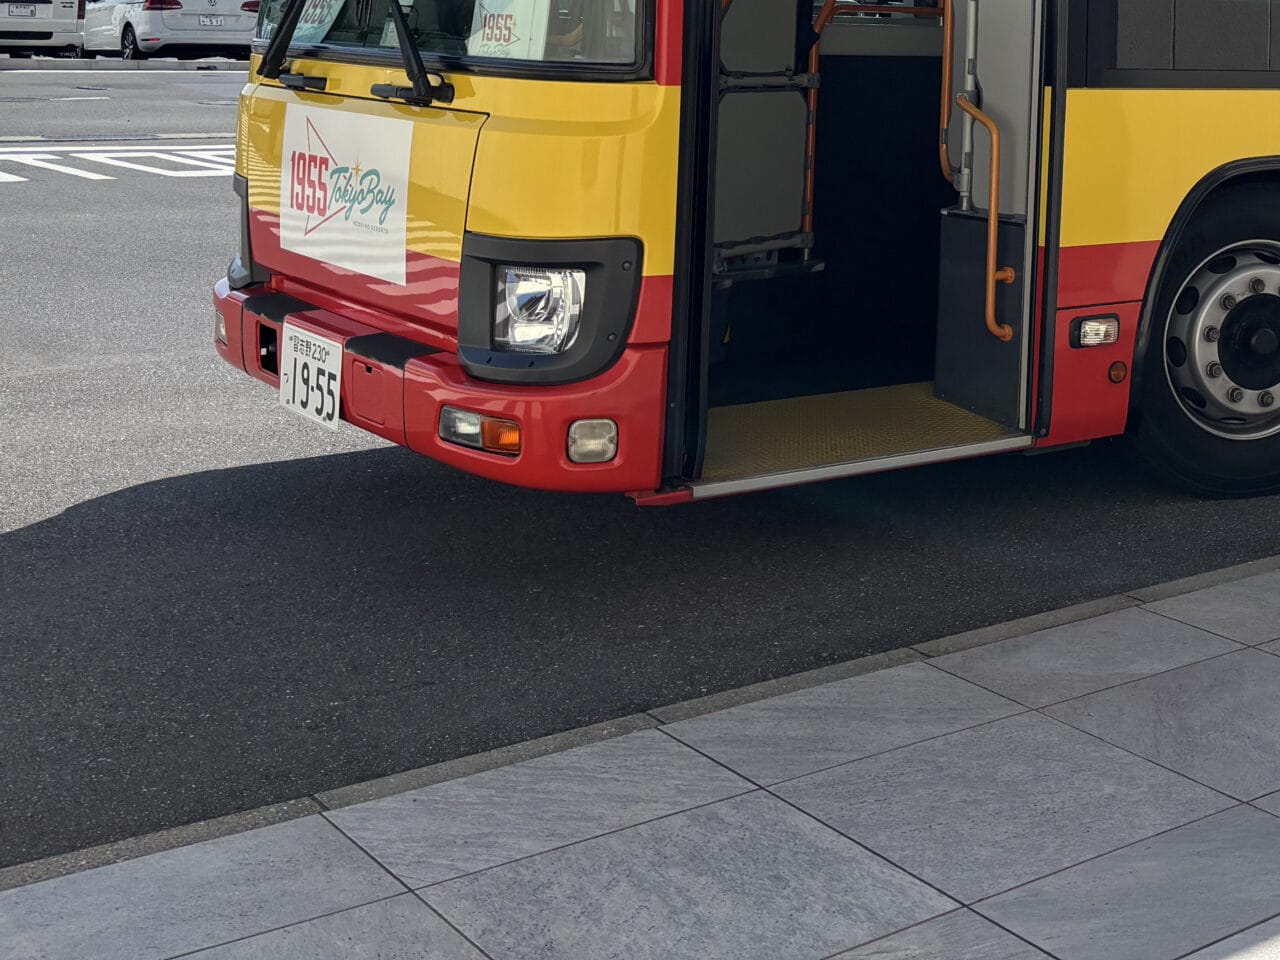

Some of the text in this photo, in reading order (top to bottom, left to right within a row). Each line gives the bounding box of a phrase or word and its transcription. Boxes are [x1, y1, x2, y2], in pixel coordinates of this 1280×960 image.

[481, 13, 513, 43] 1955
[290, 150, 329, 217] 1955
[292, 357, 337, 422] 19-55
